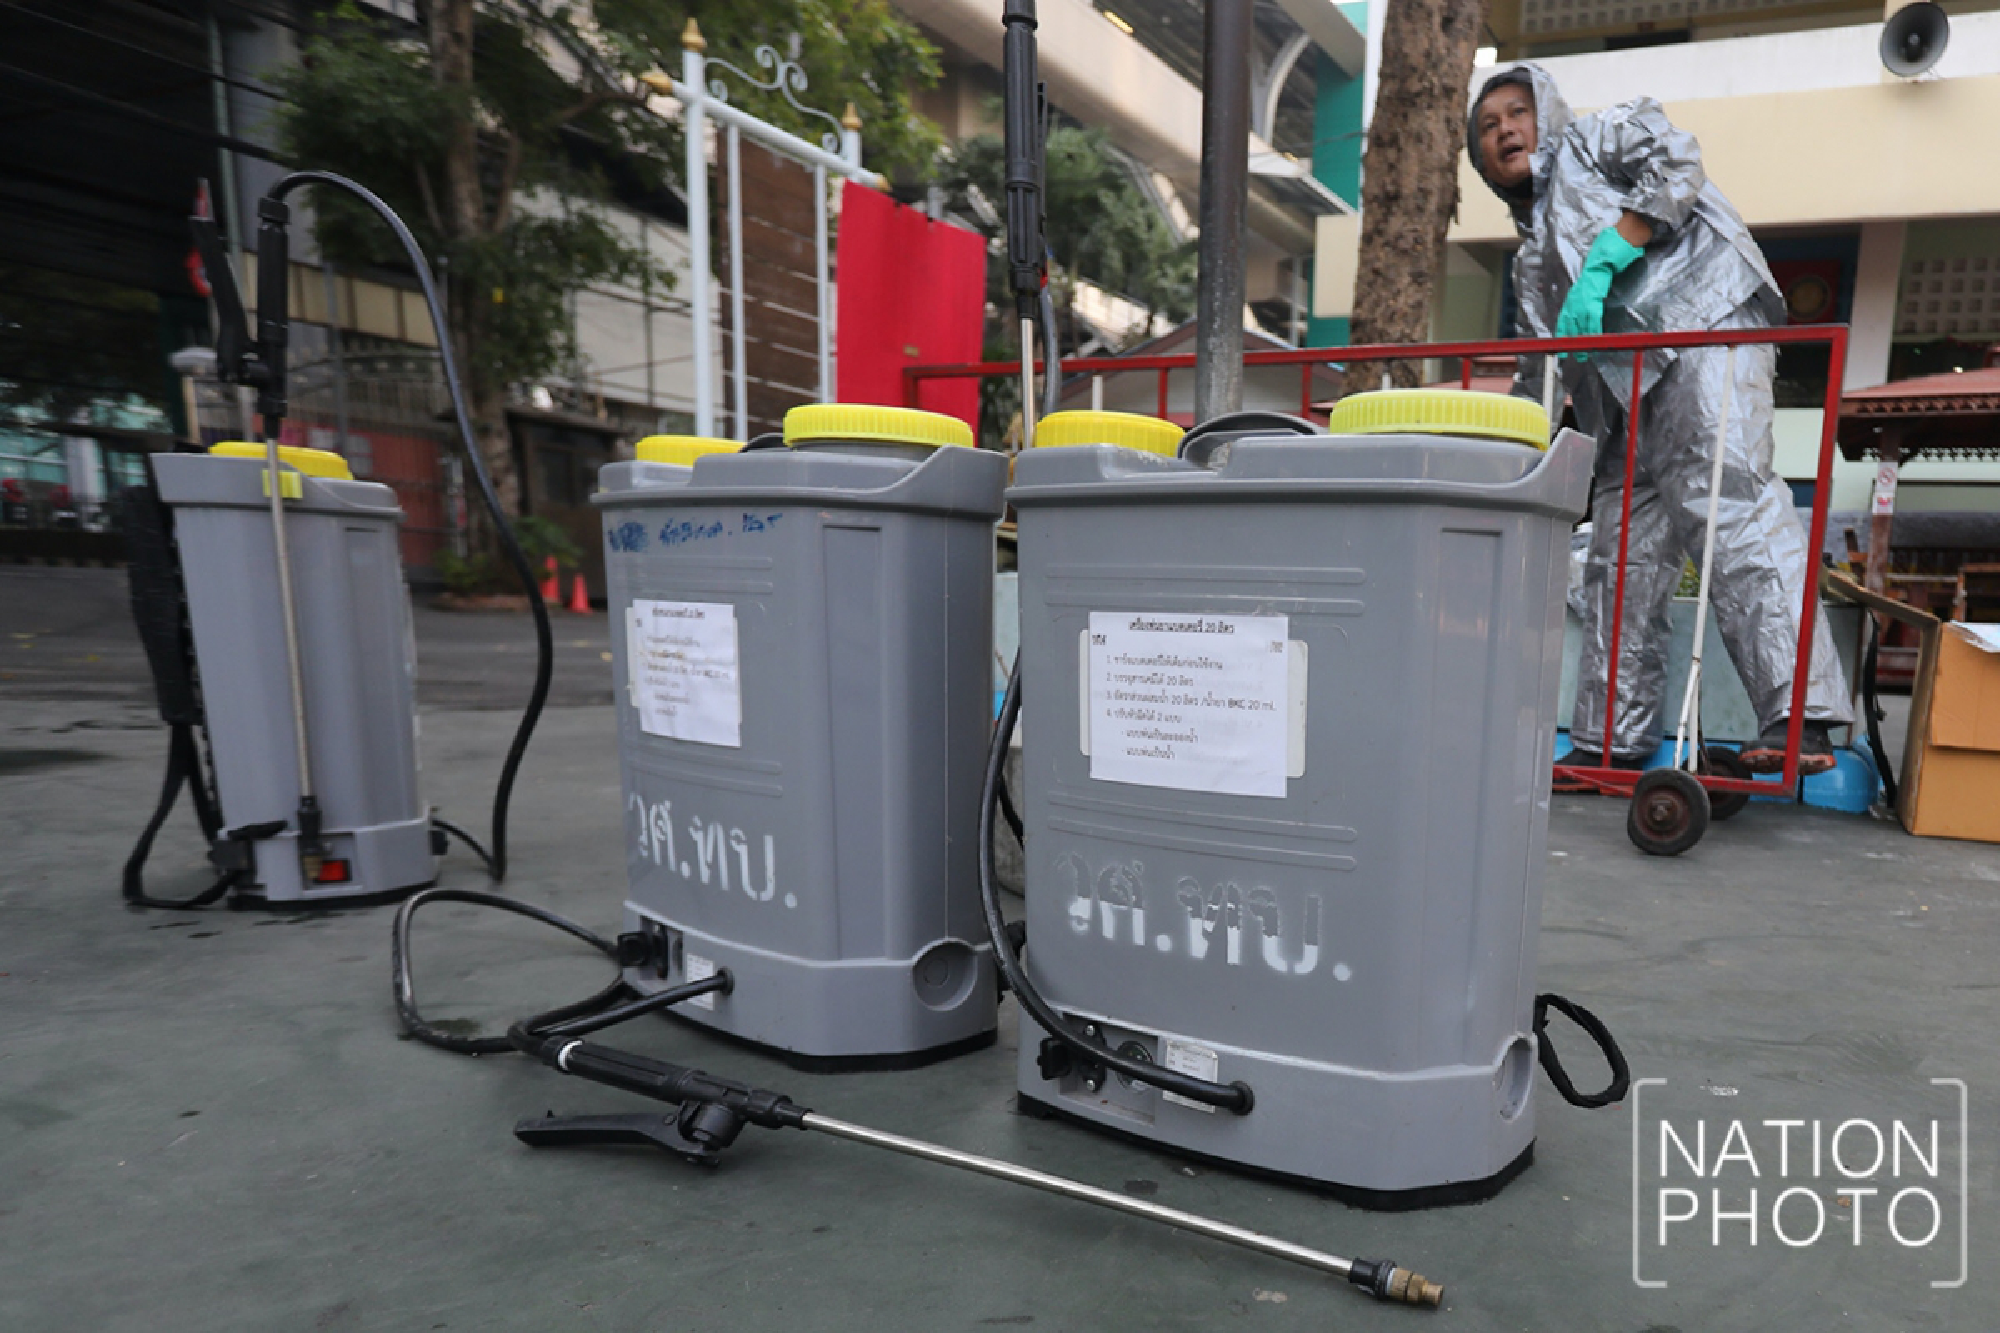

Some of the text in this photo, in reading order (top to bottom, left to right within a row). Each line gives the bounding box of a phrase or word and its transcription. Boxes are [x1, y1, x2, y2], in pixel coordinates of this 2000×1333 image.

[1204, 621, 1216, 632] 20
[1167, 675, 1178, 686] 20
[1172, 694, 1182, 706] 20
[1247, 699, 1260, 711] 20
